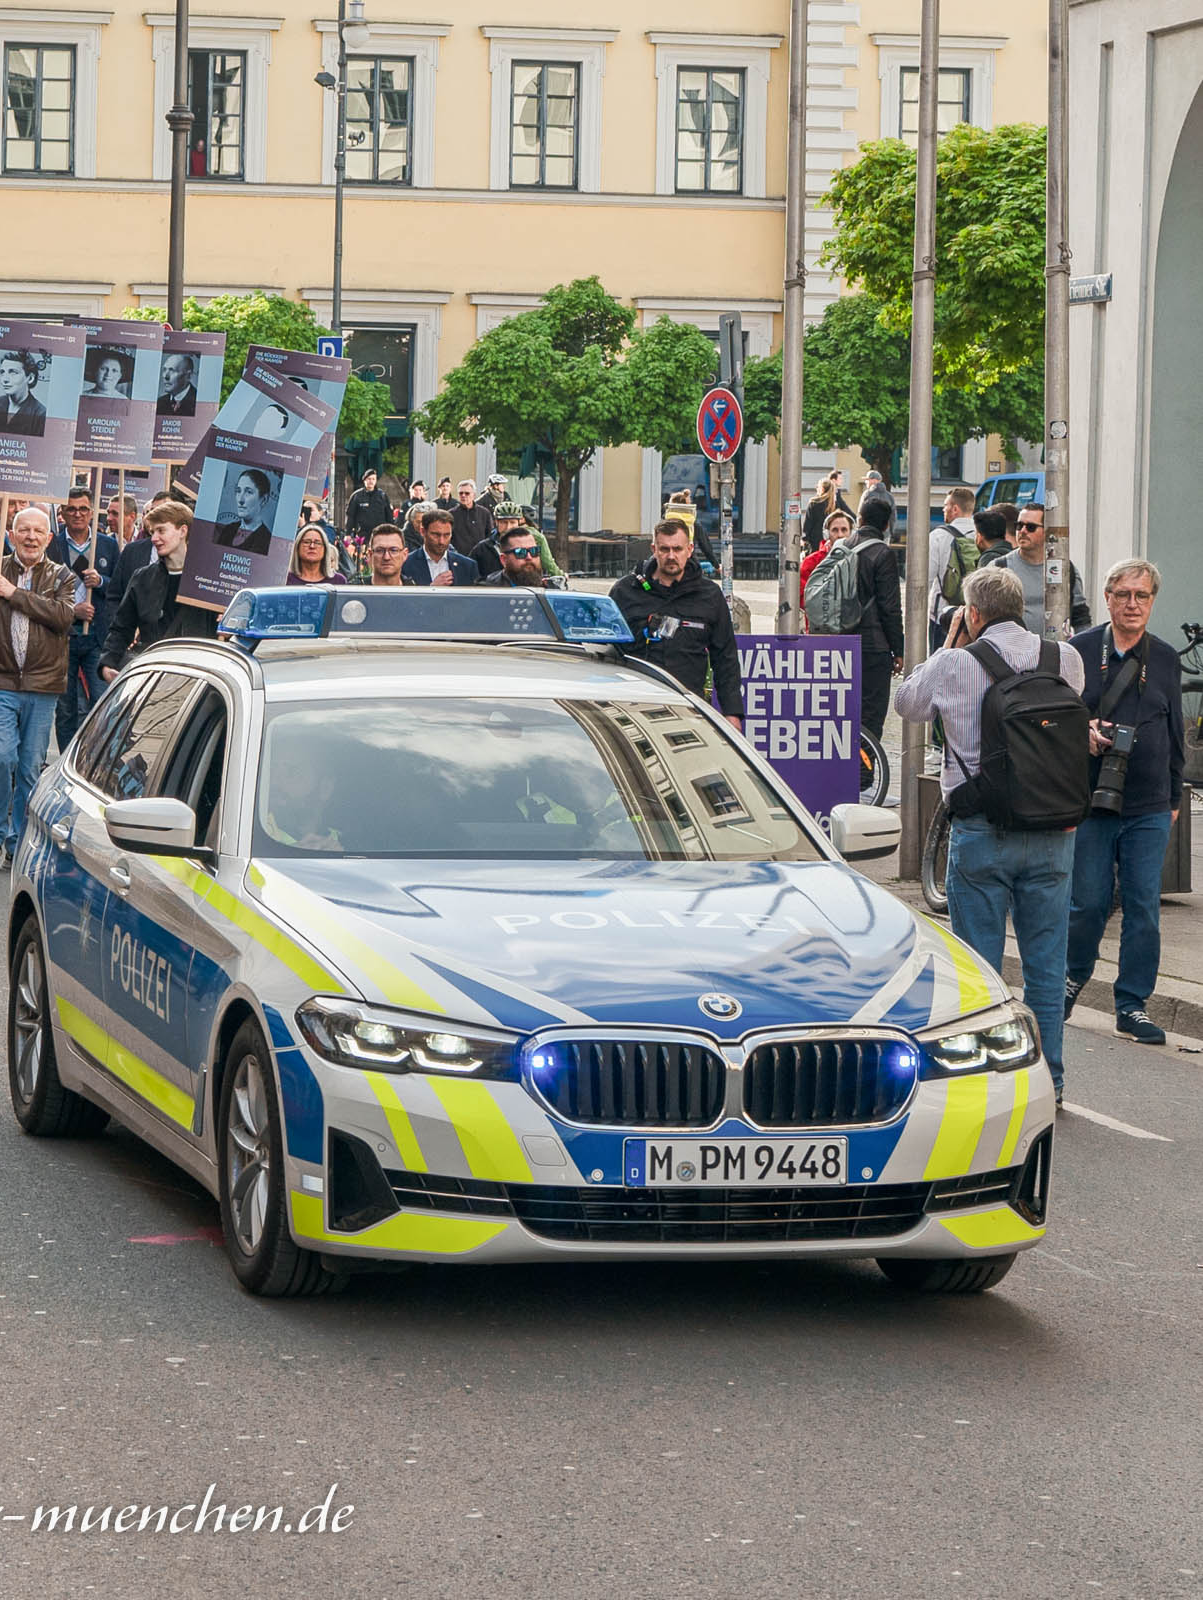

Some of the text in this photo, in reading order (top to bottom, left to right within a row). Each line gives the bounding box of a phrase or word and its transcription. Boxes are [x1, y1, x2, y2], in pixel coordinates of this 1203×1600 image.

[87, 418, 120, 428] KAROLINA
[91, 426, 115, 435] STEIDLE
[220, 561, 251, 575] HAMMEL
[223, 552, 251, 566] HEDWIG
[740, 682, 852, 717] ETTET
[745, 719, 852, 760] EBEN
[491, 909, 814, 937] POLIZEI
[110, 923, 172, 1025] POLIZEI
[649, 1144, 672, 1181] M
[699, 1144, 745, 1181] PM
[754, 1144, 841, 1180] 9448
